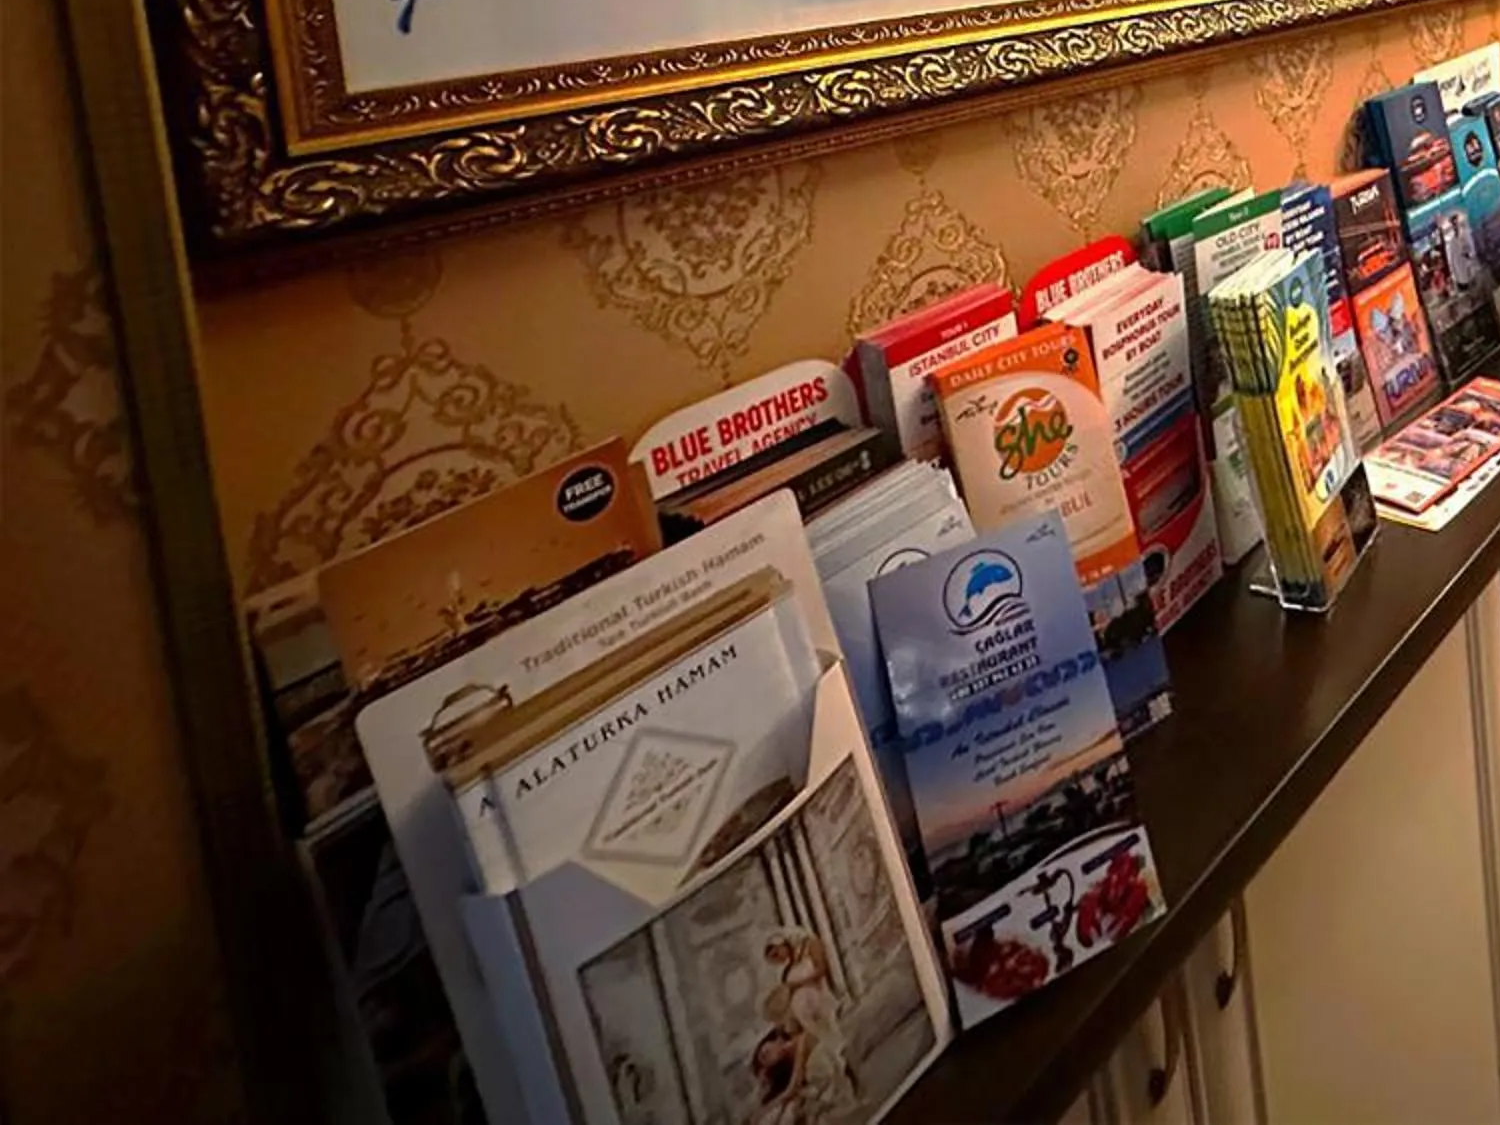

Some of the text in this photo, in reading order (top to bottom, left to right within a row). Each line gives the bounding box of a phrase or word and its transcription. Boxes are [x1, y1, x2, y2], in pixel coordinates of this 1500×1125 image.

[1216, 222, 1260, 248] OLD CITY
[1035, 280, 1069, 315] BLUE
[971, 325, 1000, 348] CITY
[997, 352, 1030, 369] CITY
[651, 376, 828, 476] BLUE BROTHERS
[1024, 443, 1079, 490] TOURS
[565, 473, 604, 501] FREE
[519, 532, 766, 675] Traditional Turkish Hamam
[515, 643, 738, 799] ALATURKA HAMAM
